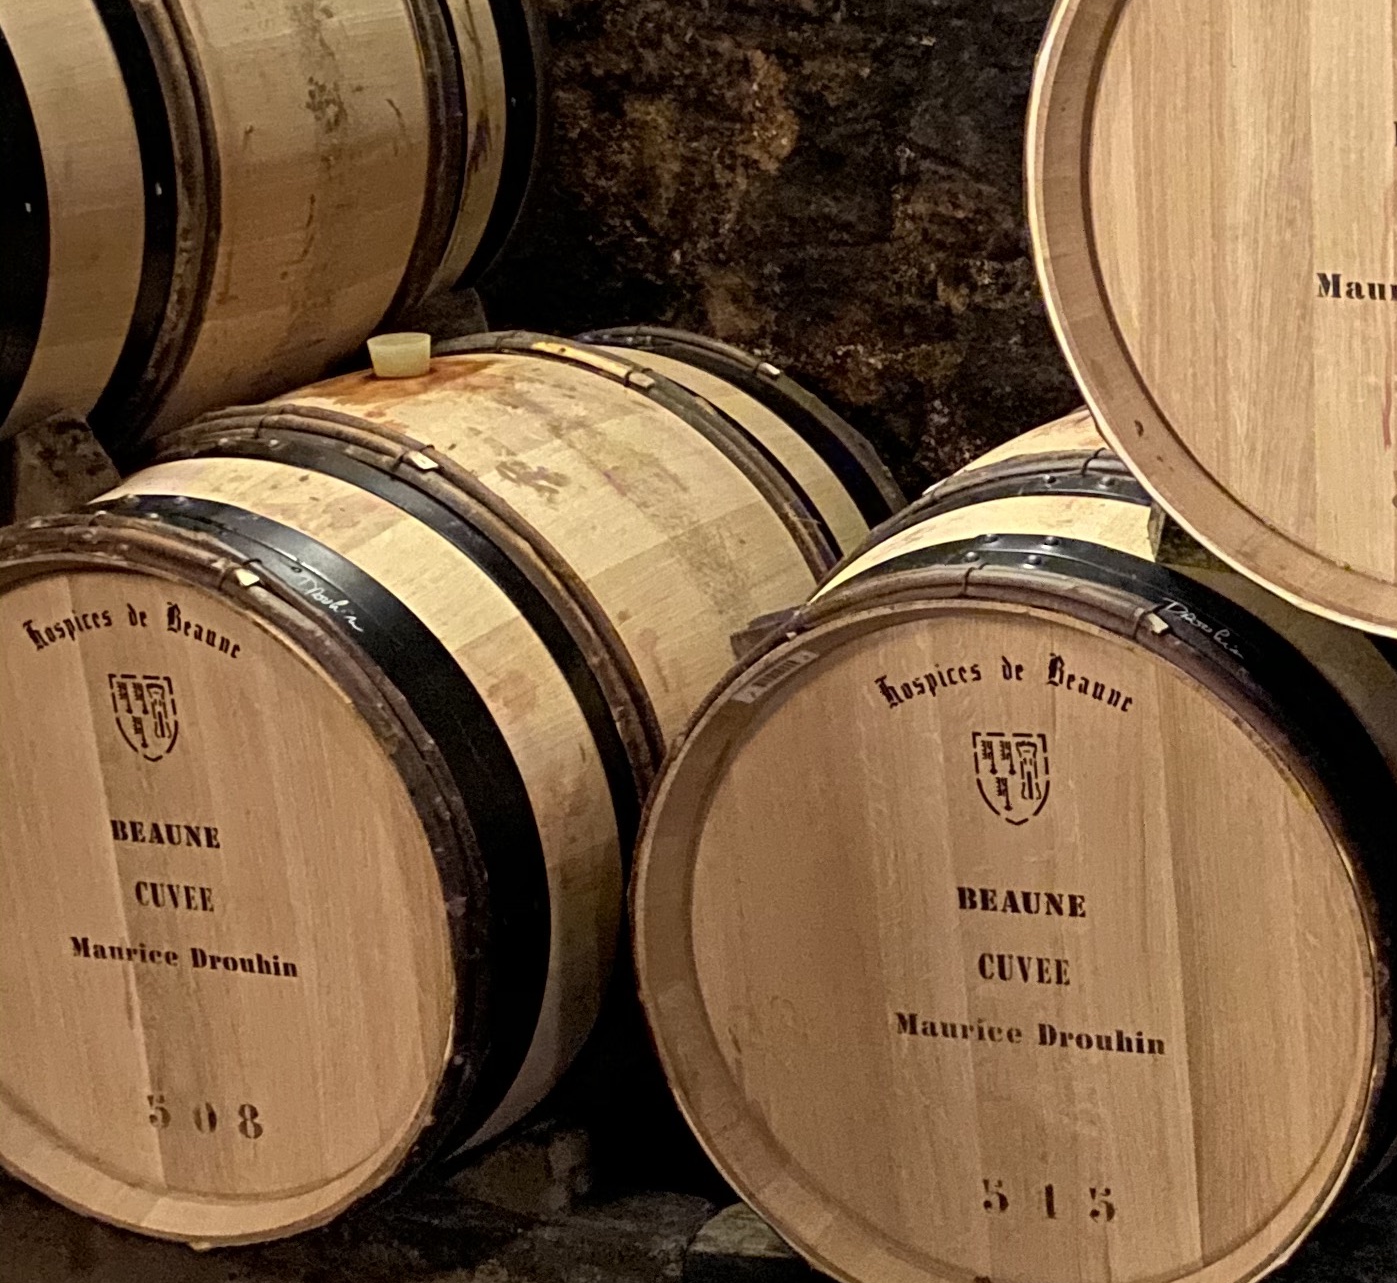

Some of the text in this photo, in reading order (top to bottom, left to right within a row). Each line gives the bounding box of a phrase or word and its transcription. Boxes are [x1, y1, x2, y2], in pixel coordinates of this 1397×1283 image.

[22, 600, 242, 660] Hospices de Beaune
[873, 651, 1134, 713] Hospices de Beaune
[109, 818, 221, 850] BEAUNE
[134, 880, 215, 913] CUVEE
[956, 885, 1087, 919] BEAUNE
[69, 935, 299, 978] Maurice Drouhin
[976, 952, 1071, 987] CUVEE
[893, 1012, 1166, 1056] Maurice Drouhin
